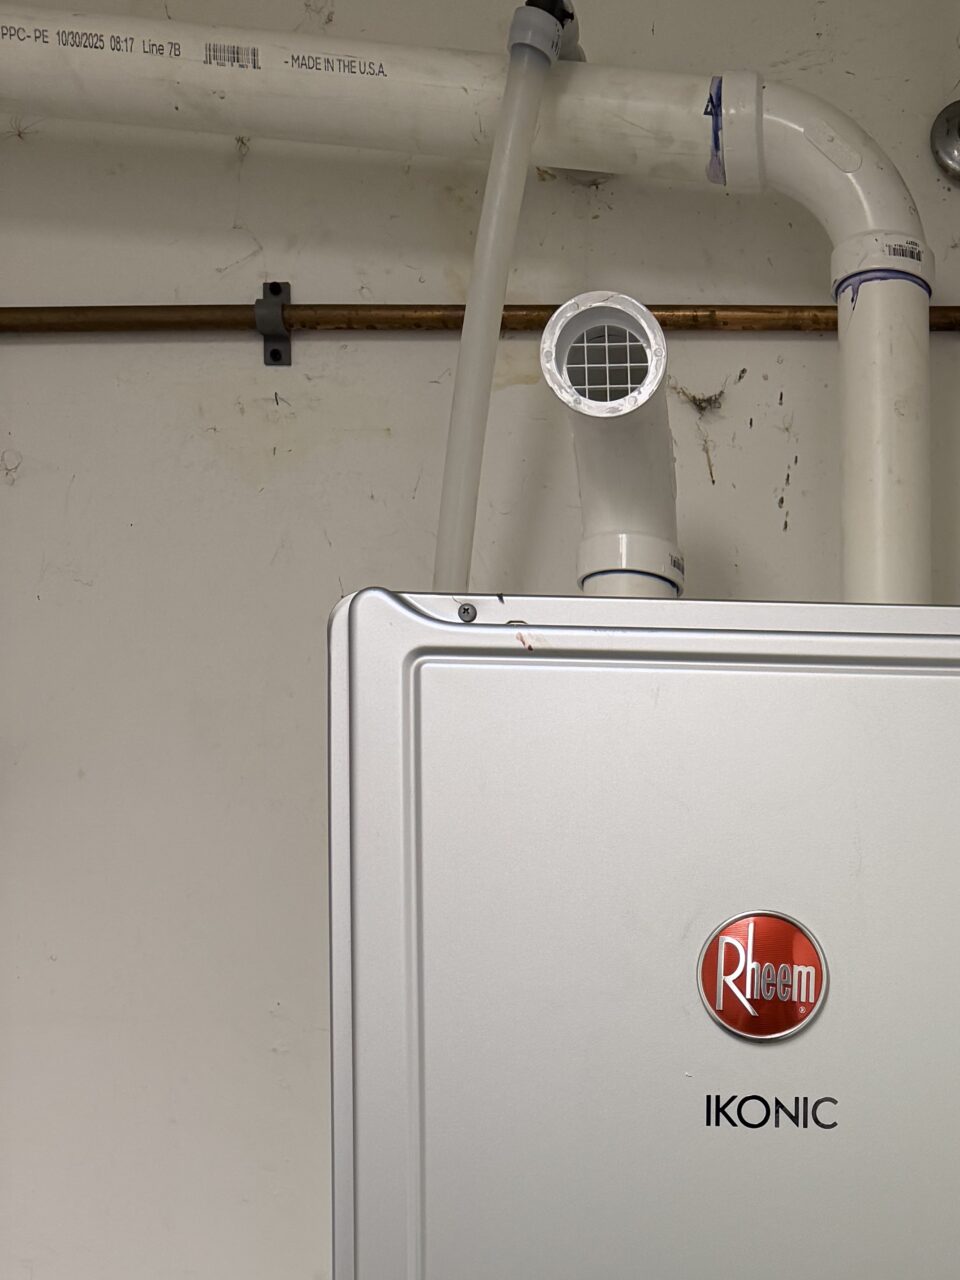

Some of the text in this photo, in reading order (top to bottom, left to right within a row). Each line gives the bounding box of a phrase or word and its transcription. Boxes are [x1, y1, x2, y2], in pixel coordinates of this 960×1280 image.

[56, 30, 105, 50] 10/30/2025
[110, 35, 135, 53] 08:17
[142, 40, 165, 56] Line
[168, 42, 182, 57] 7B
[291, 54, 322, 71] MADE
[324, 57, 335, 72] IN
[337, 58, 357, 74] THE
[359, 60, 388, 77] U.S.A.
[715, 920, 816, 1017] Rheem
[705, 1094, 839, 1130] IKONIC
